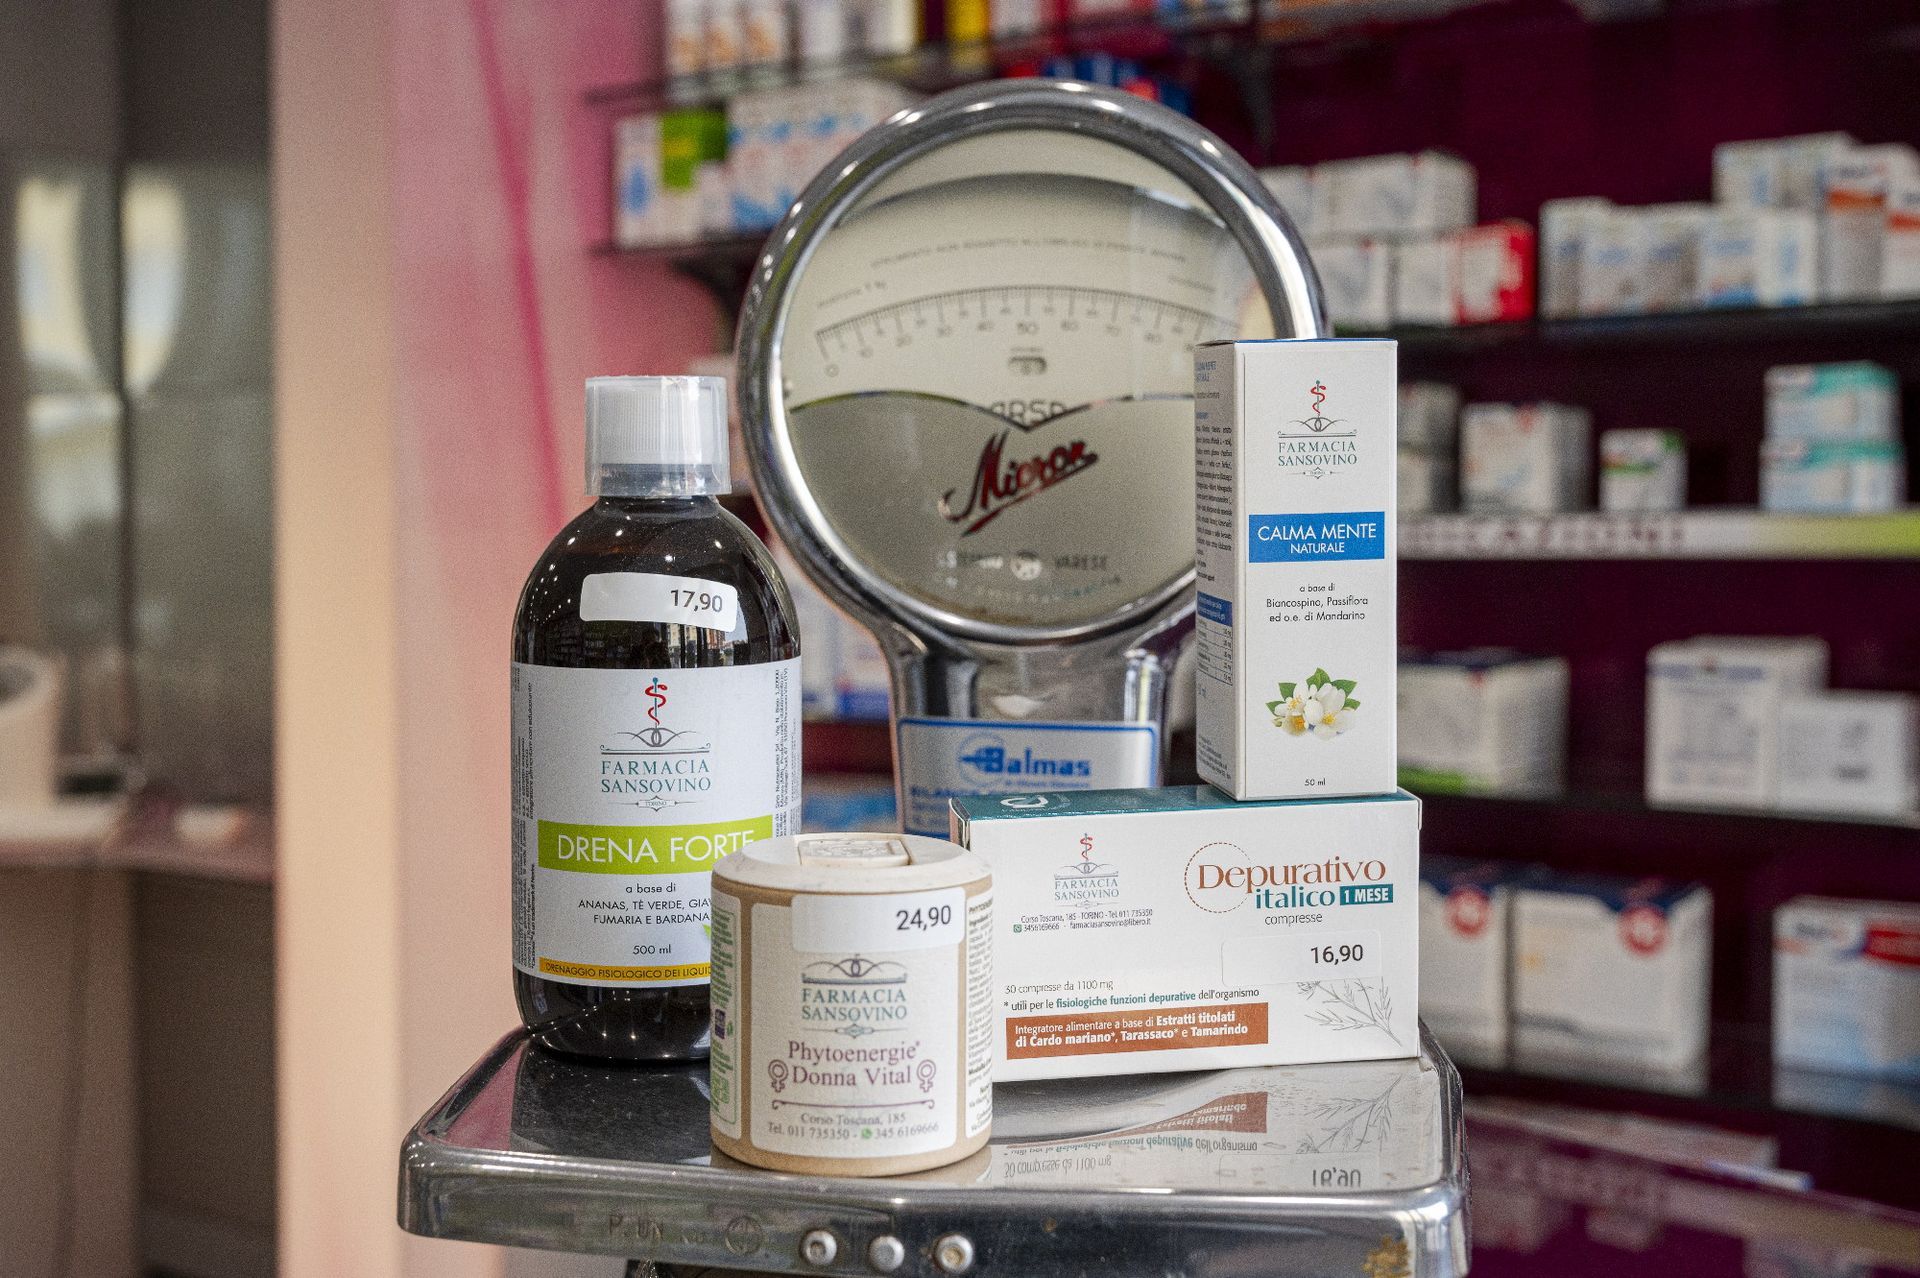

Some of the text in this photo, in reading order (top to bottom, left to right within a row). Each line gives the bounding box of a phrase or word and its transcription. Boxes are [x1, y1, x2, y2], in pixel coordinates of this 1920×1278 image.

[1278, 441, 1357, 453] FARMACIA
[1278, 454, 1357, 466] SANSOVINO
[1257, 524, 1317, 541] CALMA
[1321, 523, 1377, 540] MENTE
[1290, 542, 1345, 554] NATURALE
[1308, 584, 1326, 592] base
[1328, 582, 1335, 591] di
[671, 589, 722, 613] 17,90
[1266, 595, 1368, 609] Biancospino, Passiflora
[1269, 612, 1281, 622] ed
[1304, 611, 1313, 621] di
[1316, 610, 1366, 621] Mandarino
[601, 759, 710, 776] FARMACIA
[601, 777, 711, 794] SANSOVINO
[558, 830, 754, 863] DRENA FORTE
[1198, 856, 1386, 894] Depurativo
[637, 883, 662, 893] base
[666, 882, 676, 892] di
[1055, 878, 1118, 889] FARMACIA
[1055, 889, 1119, 900] SANSOVINO
[1256, 886, 1389, 909] italico 1 MESE
[578, 899, 629, 911] ANANAS,
[647, 900, 685, 910] VERDE,
[593, 914, 642, 925] FUMARIA
[645, 915, 652, 924] E
[896, 905, 951, 930] 24,90
[1021, 915, 1039, 923] Corso
[1040, 913, 1065, 922] Toscana,
[1265, 913, 1323, 927] compresse
[632, 943, 672, 955] 500 ml
[1310, 944, 1363, 965] 16,90
[545, 962, 596, 978] DRENAGGIO
[598, 969, 662, 979] FISIOLOGICO
[664, 969, 681, 978] DEI
[1018, 983, 1061, 994] compresse
[1064, 981, 1074, 991] da
[1078, 980, 1098, 990] 1100
[1100, 980, 1114, 990] mg
[802, 988, 907, 1004] FARMACIA
[1011, 988, 1260, 1012] utili per le fisiologiche funzioni depurative dell'organismo
[802, 1005, 907, 1022] SANSOVINO
[1015, 1024, 1063, 1035] Integratore
[1065, 1020, 1112, 1031] alimentare
[1122, 1019, 1143, 1029] base
[1145, 1016, 1154, 1026] di
[1156, 1013, 1195, 1026] Estratti
[1198, 1010, 1236, 1023] titolati
[1016, 1036, 1026, 1047] di
[1030, 1034, 1062, 1047] Cardo
[1182, 1030, 1188, 1038] e
[1191, 1024, 1248, 1037] Tamarindo
[792, 1066, 911, 1086] Donna Vital
[801, 1112, 906, 1126] Corso Toscana, 185
[768, 1122, 784, 1134] Tel.
[788, 1127, 805, 1137] 011
[875, 1128, 894, 1139] 345
